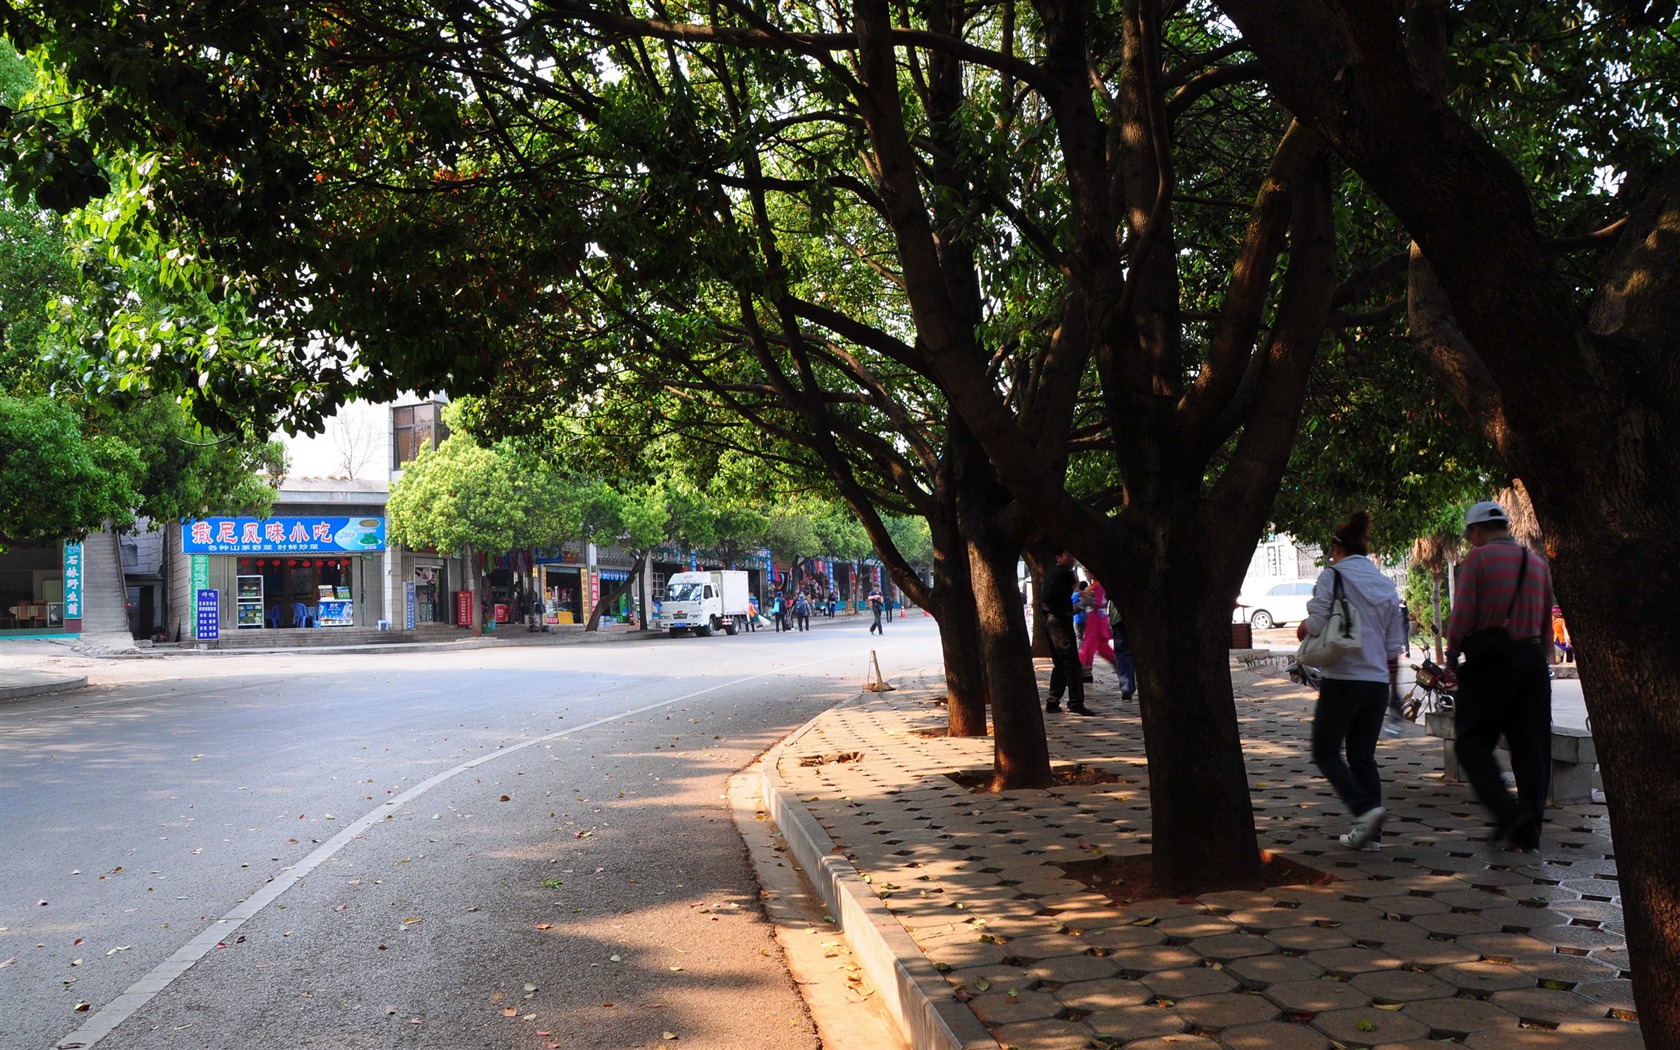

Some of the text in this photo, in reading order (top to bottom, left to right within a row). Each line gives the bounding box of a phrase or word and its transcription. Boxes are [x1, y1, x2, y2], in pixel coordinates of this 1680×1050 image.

[192, 521, 333, 544] 撒尼风味小吃
[66, 555, 80, 616] 石林野生菌
